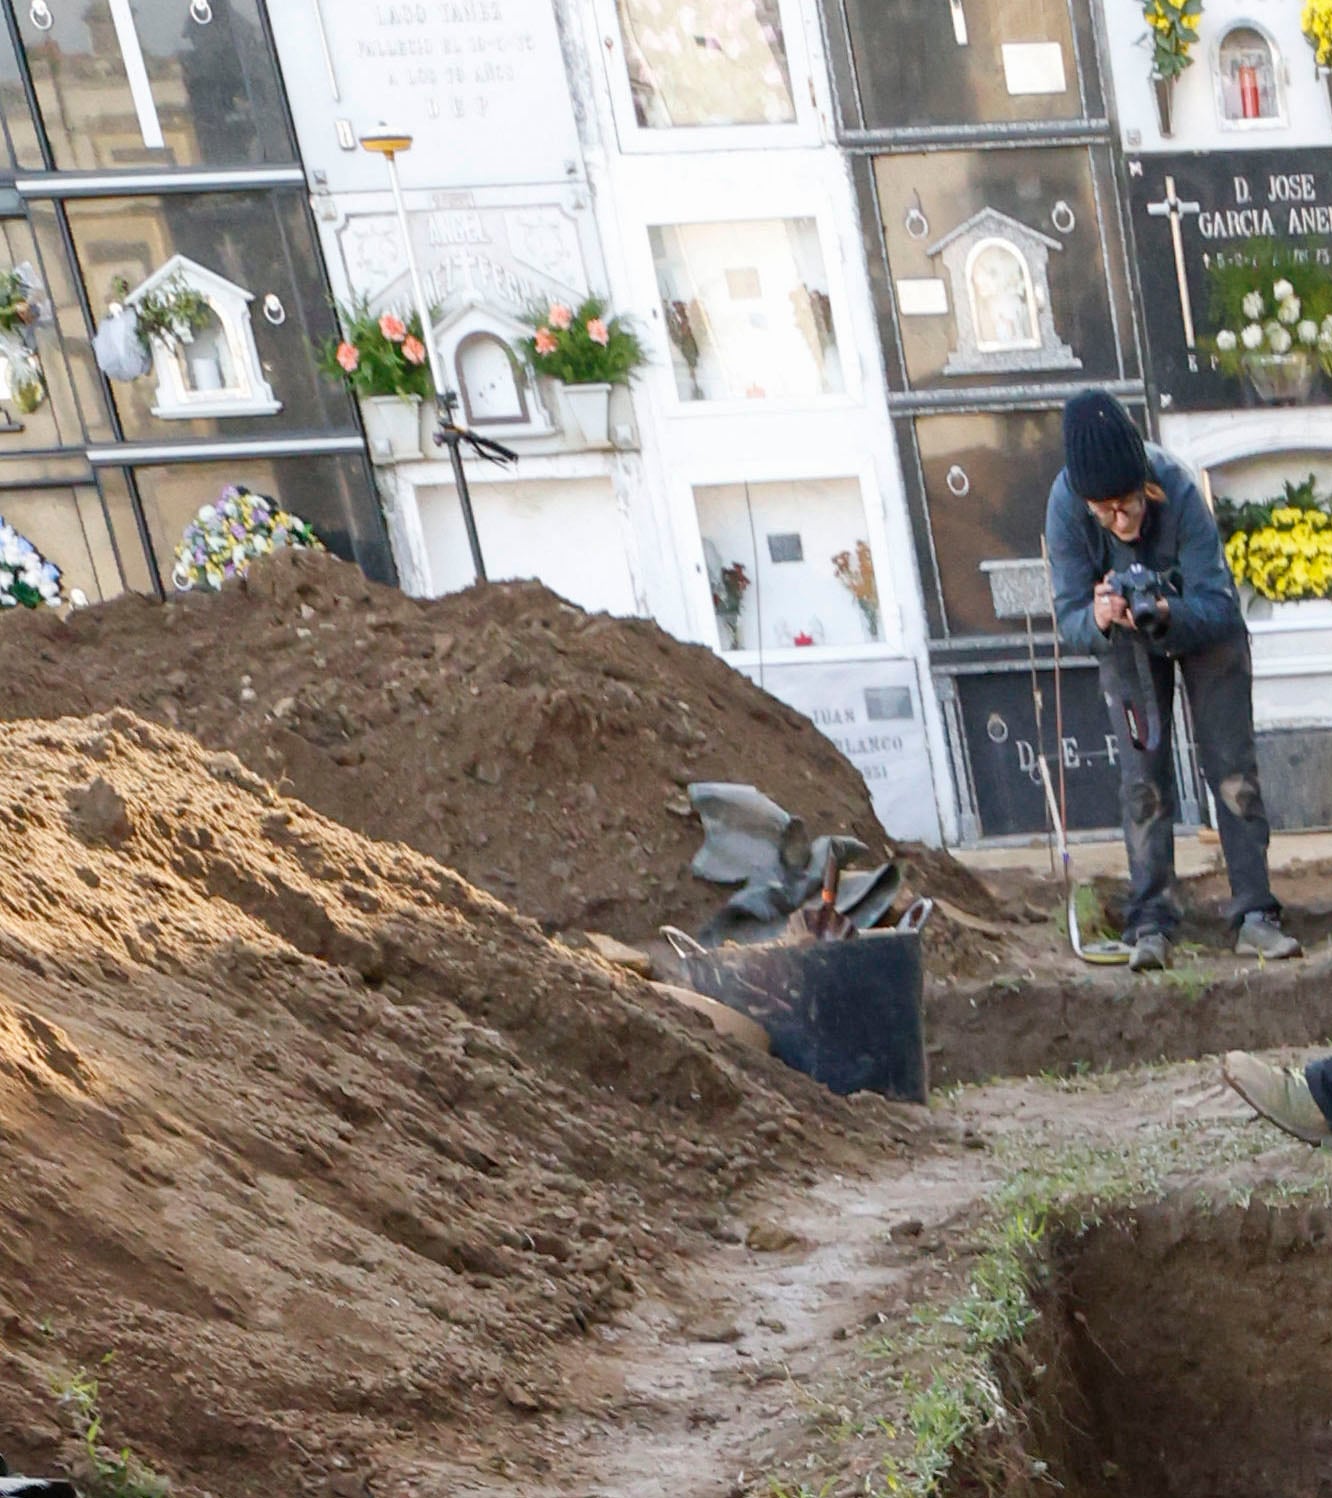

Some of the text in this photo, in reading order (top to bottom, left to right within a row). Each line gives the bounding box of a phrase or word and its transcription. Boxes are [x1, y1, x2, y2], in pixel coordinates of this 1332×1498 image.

[1267, 174, 1316, 203] JOSE
[1197, 208, 1277, 240] GARCIA
[812, 708, 857, 725] JUAN
